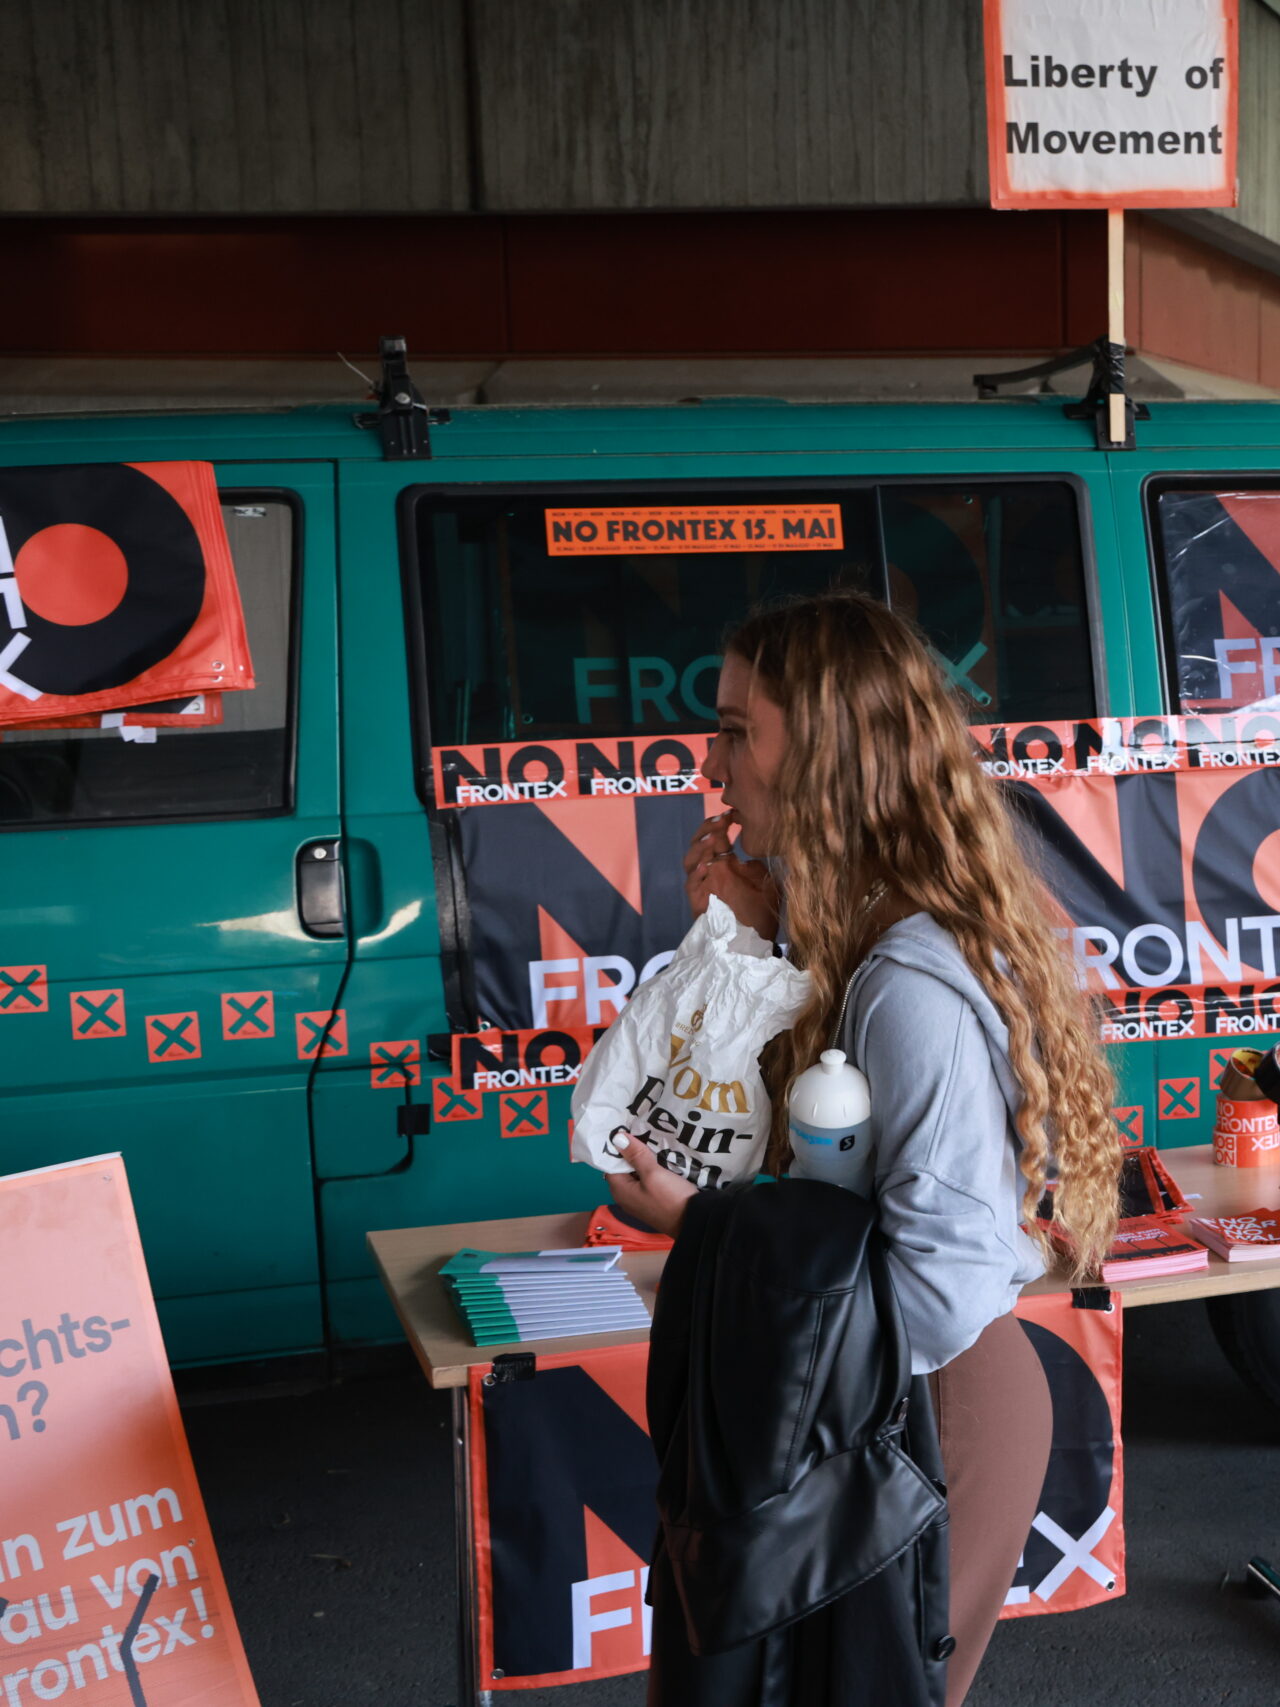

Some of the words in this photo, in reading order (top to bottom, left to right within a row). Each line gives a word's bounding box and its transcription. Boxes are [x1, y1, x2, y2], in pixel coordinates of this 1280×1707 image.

[1003, 55, 1157, 97] Liberty
[1185, 57, 1224, 89] of
[1005, 122, 1223, 154] Movement
[553, 520, 598, 543] NO
[606, 519, 737, 542] FRONTEX
[742, 518, 775, 540] 15.
[782, 517, 836, 539] MAI
[440, 745, 565, 803] NO
[576, 739, 696, 795] NO
[456, 780, 567, 804] FRONTEX
[591, 774, 699, 796] FRONTEX
[976, 758, 1066, 778] RONTEX
[1087, 752, 1182, 774] FRONTEX
[460, 1031, 581, 1090] NO
[473, 1064, 583, 1091] FRONTEX
[1100, 1019, 1195, 1041] FRONTEX
[1218, 1216, 1257, 1225] NO
[1220, 1219, 1277, 1230] WAR
[1224, 1229, 1263, 1237] NO
[56, 1487, 183, 1560] zum
[90, 1545, 198, 1609] von
[0, 1586, 214, 1707] rontex!
